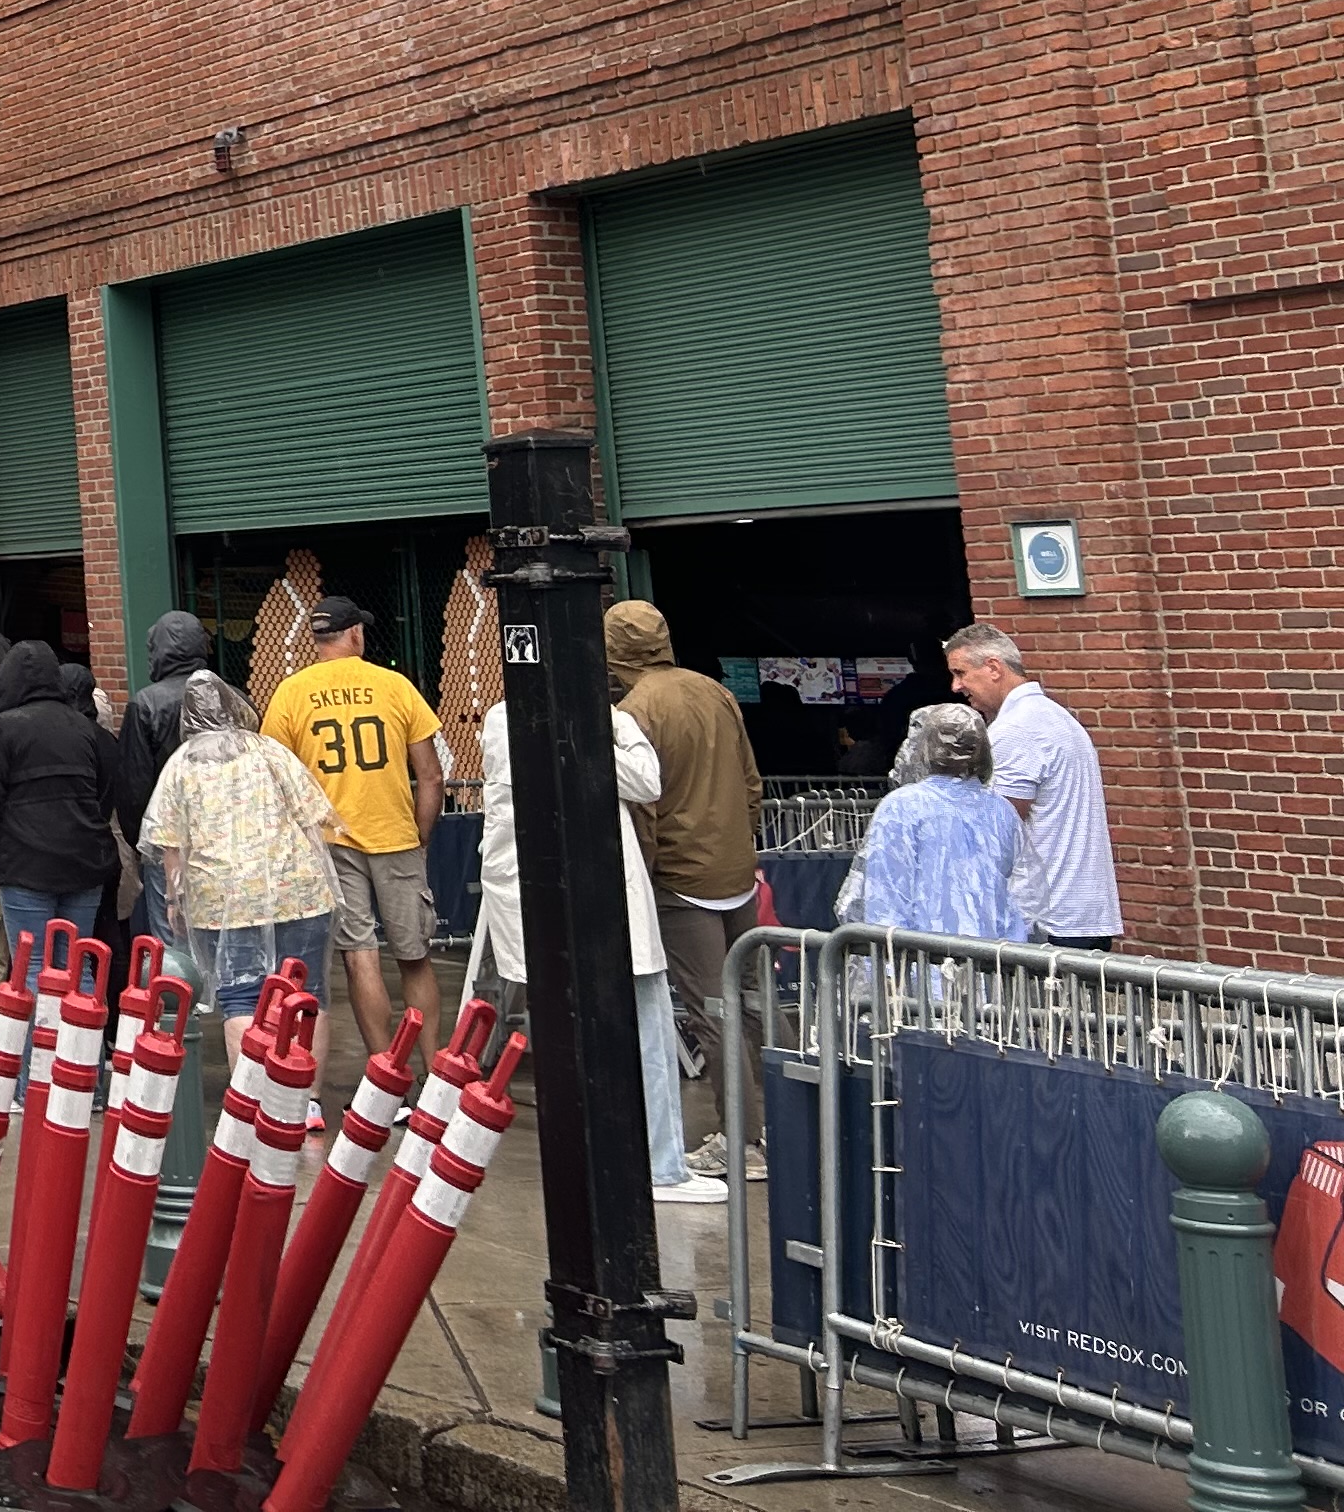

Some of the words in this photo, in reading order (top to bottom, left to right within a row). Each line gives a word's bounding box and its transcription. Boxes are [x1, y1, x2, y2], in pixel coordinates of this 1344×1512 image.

[308, 687, 375, 709] SKENES
[310, 715, 389, 774] 30
[1018, 1318, 1061, 1344] VISIT
[1300, 1397, 1329, 1419] OR
